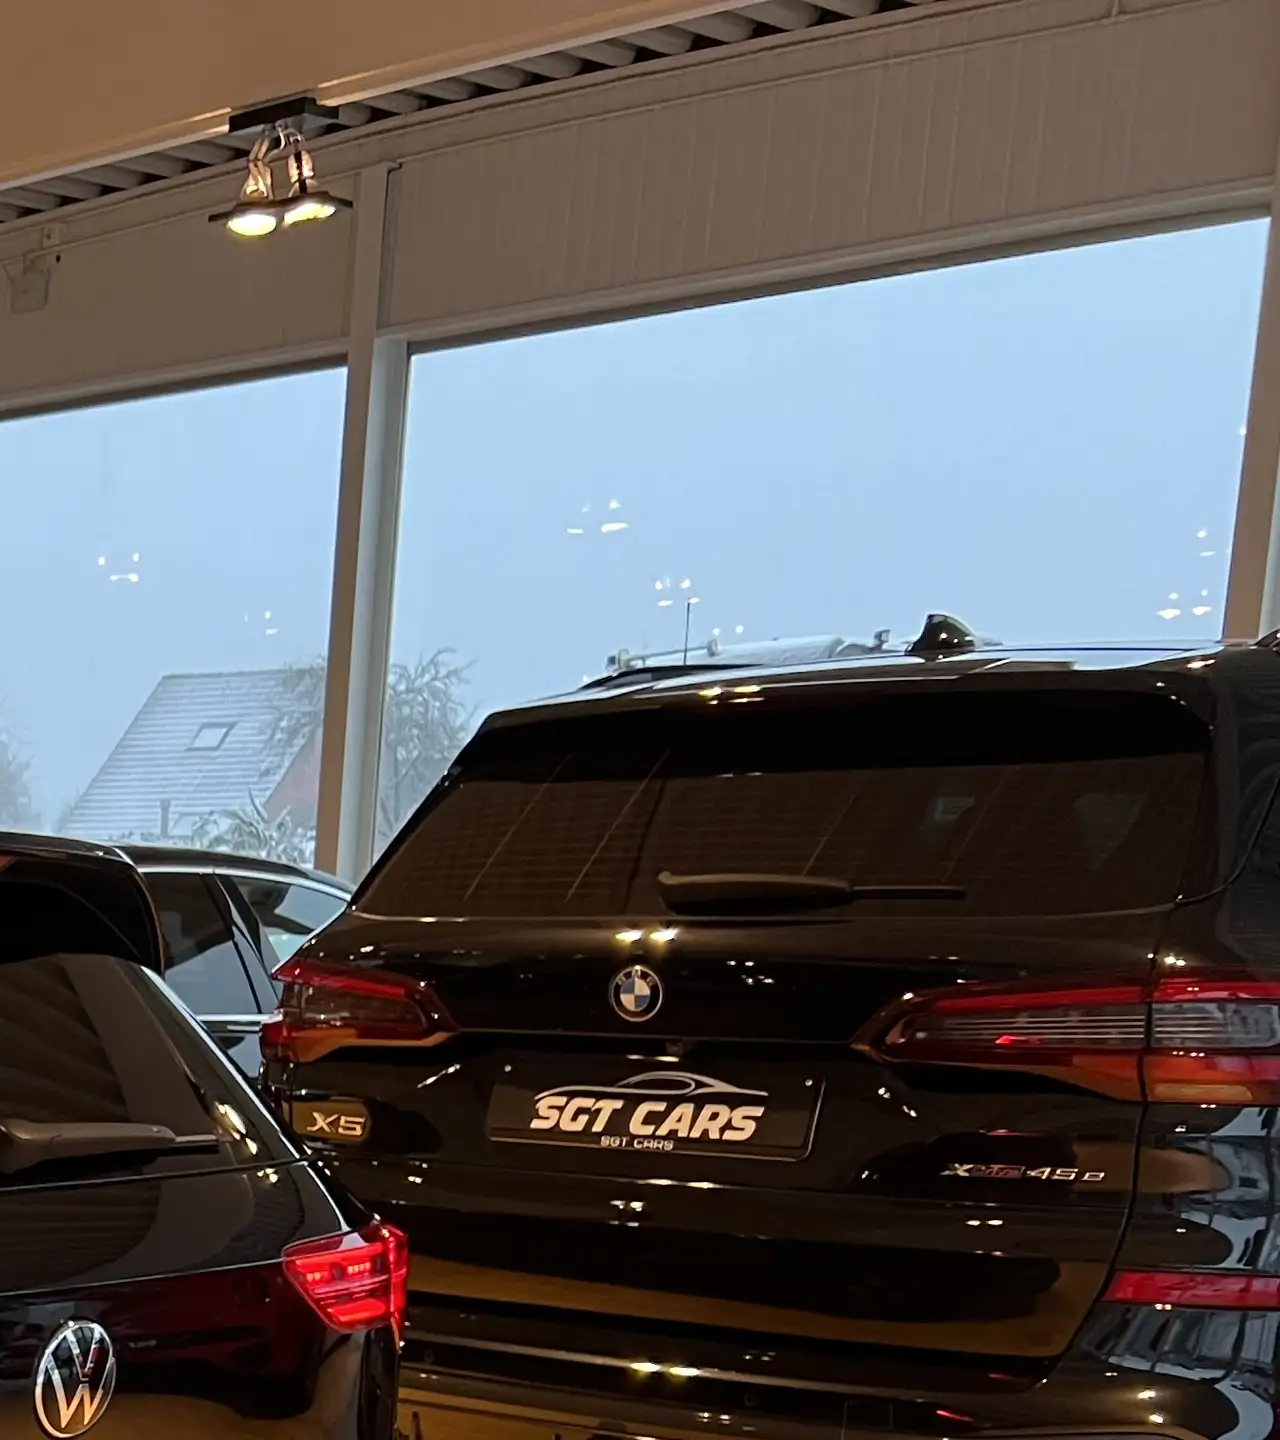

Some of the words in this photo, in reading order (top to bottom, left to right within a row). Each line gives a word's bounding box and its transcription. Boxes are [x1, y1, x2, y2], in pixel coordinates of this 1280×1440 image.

[306, 1111, 367, 1136] X5
[529, 1095, 625, 1133] SGT
[629, 1101, 766, 1142] CARS
[600, 1135, 630, 1147] SGT
[633, 1138, 675, 1151] CARS
